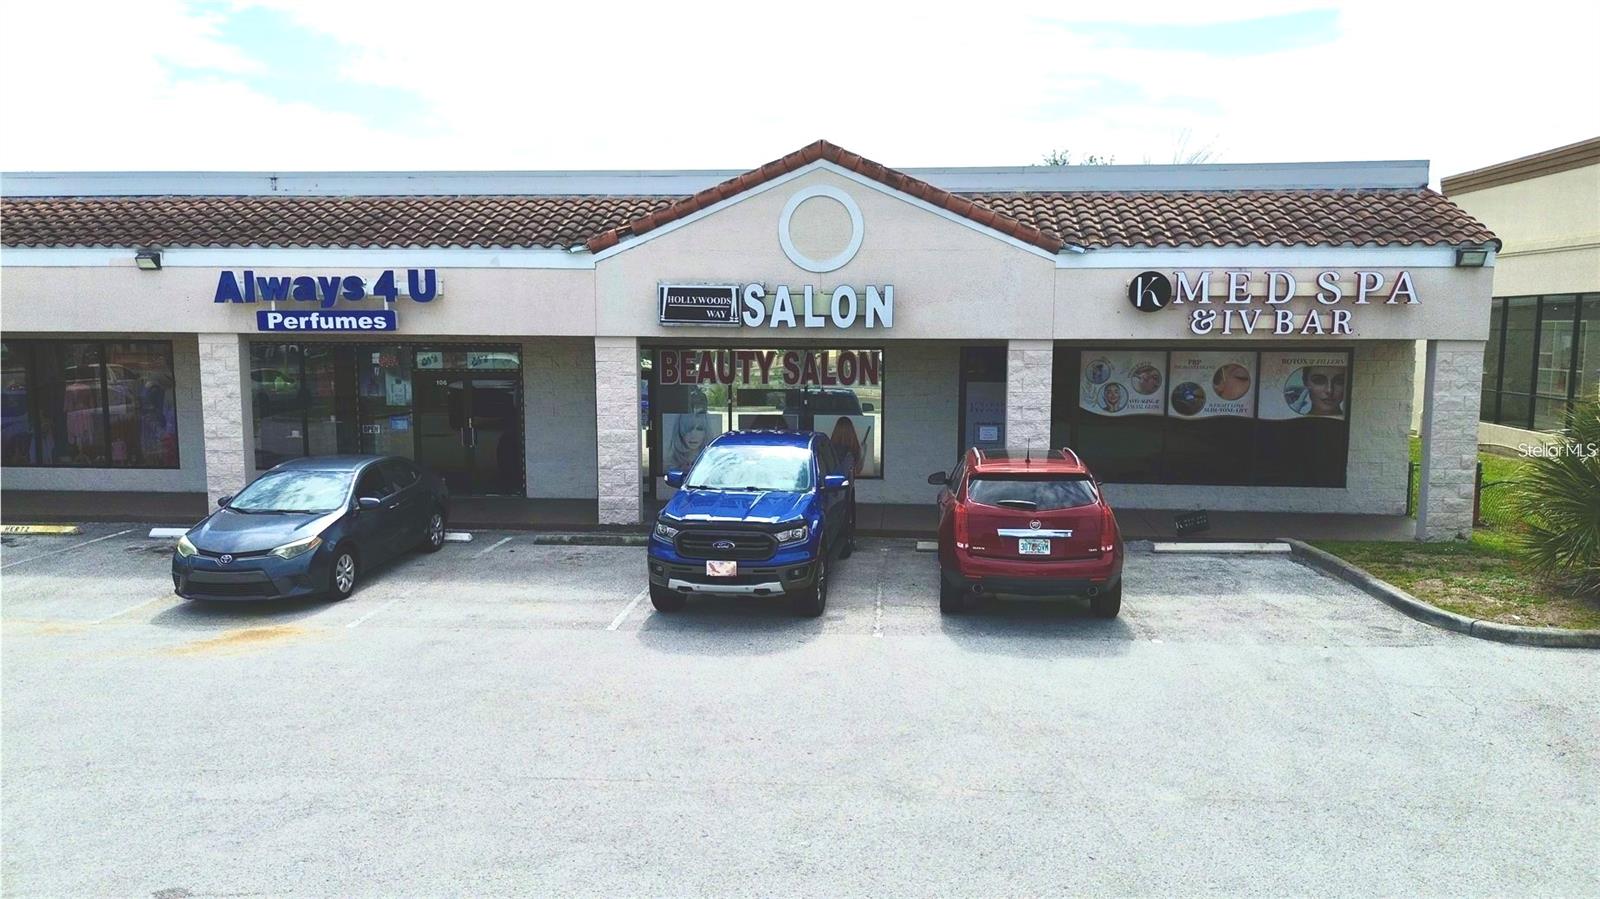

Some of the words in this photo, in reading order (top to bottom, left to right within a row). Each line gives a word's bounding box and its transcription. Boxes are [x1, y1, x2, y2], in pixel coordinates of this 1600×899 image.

[214, 270, 367, 309] Always
[373, 270, 399, 303] 4
[407, 269, 438, 303] U
[667, 295, 732, 305] HOLLYWOODS
[1136, 276, 1163, 308] K
[1172, 271, 1297, 305] MED
[1316, 271, 1423, 305] SPA
[706, 310, 728, 319] WAY
[742, 283, 895, 329] SALON
[266, 312, 388, 330] Perfumes
[1190, 309, 1217, 335] &
[1221, 309, 1262, 335] IV
[1273, 309, 1354, 335] BAR
[659, 350, 777, 385] BEAUTY
[783, 350, 880, 386] SALON
[363, 425, 379, 433] OPEN
